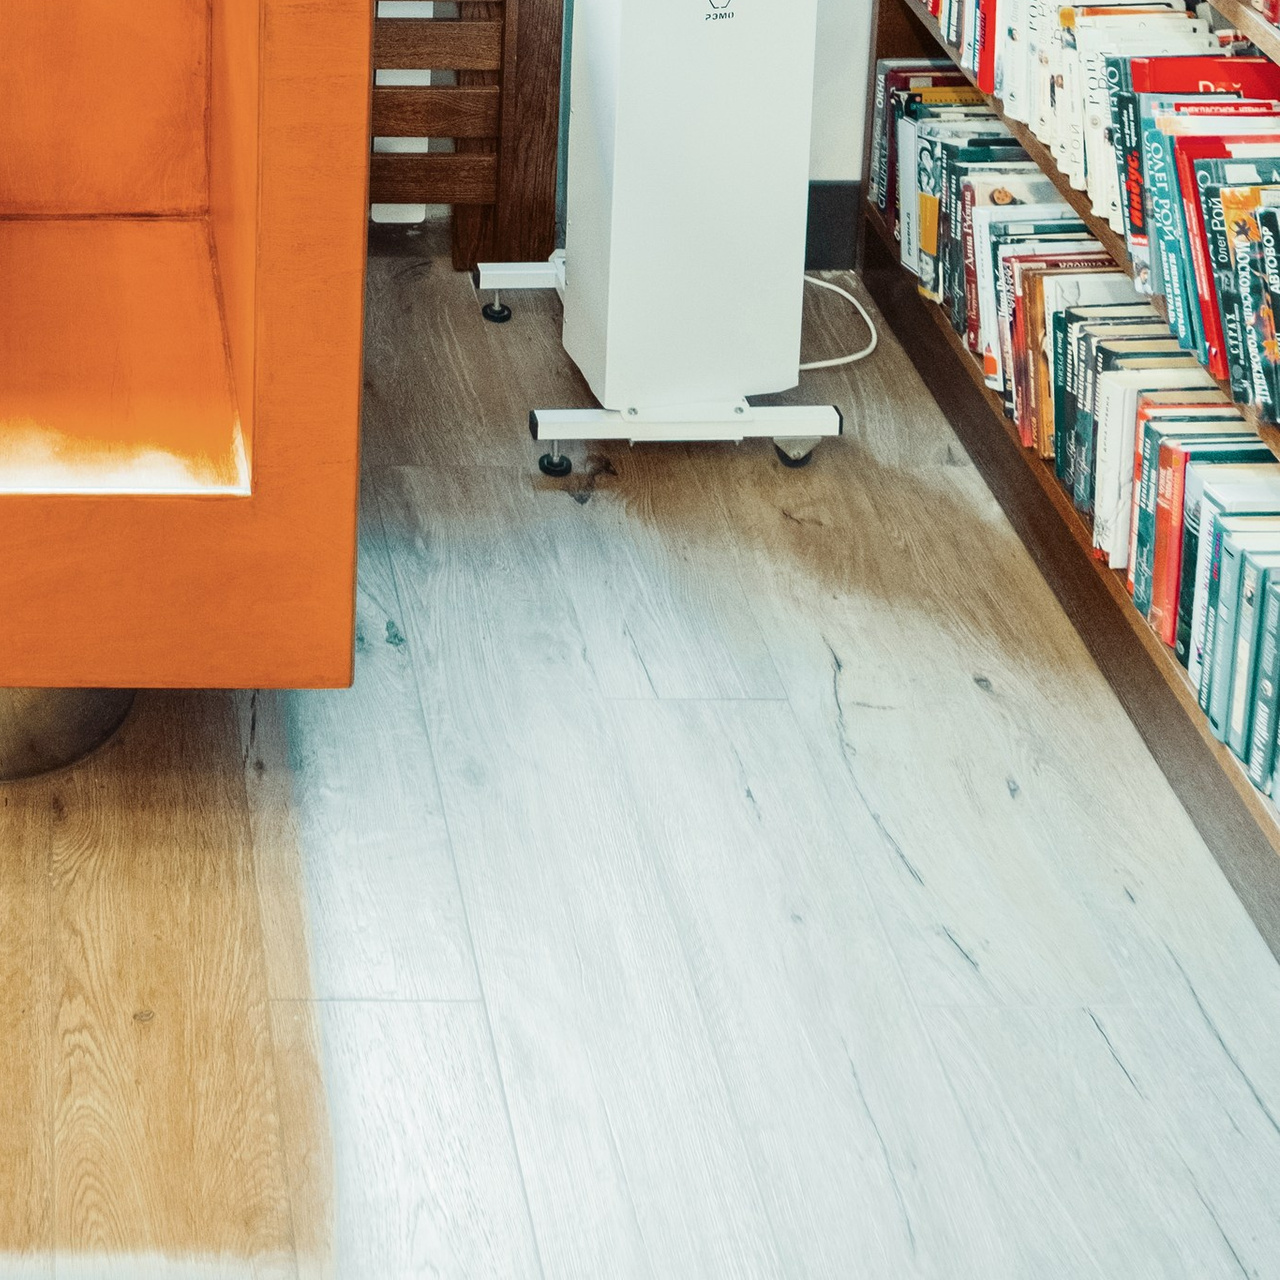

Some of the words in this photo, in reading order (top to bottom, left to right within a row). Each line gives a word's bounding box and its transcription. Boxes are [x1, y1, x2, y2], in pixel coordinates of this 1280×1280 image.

[876, 74, 885, 109] ОКНА
[1151, 143, 1169, 192] ОЛЕГ
[1159, 200, 1175, 241] РОЙ
[1226, 312, 1238, 354] СТРАХ
